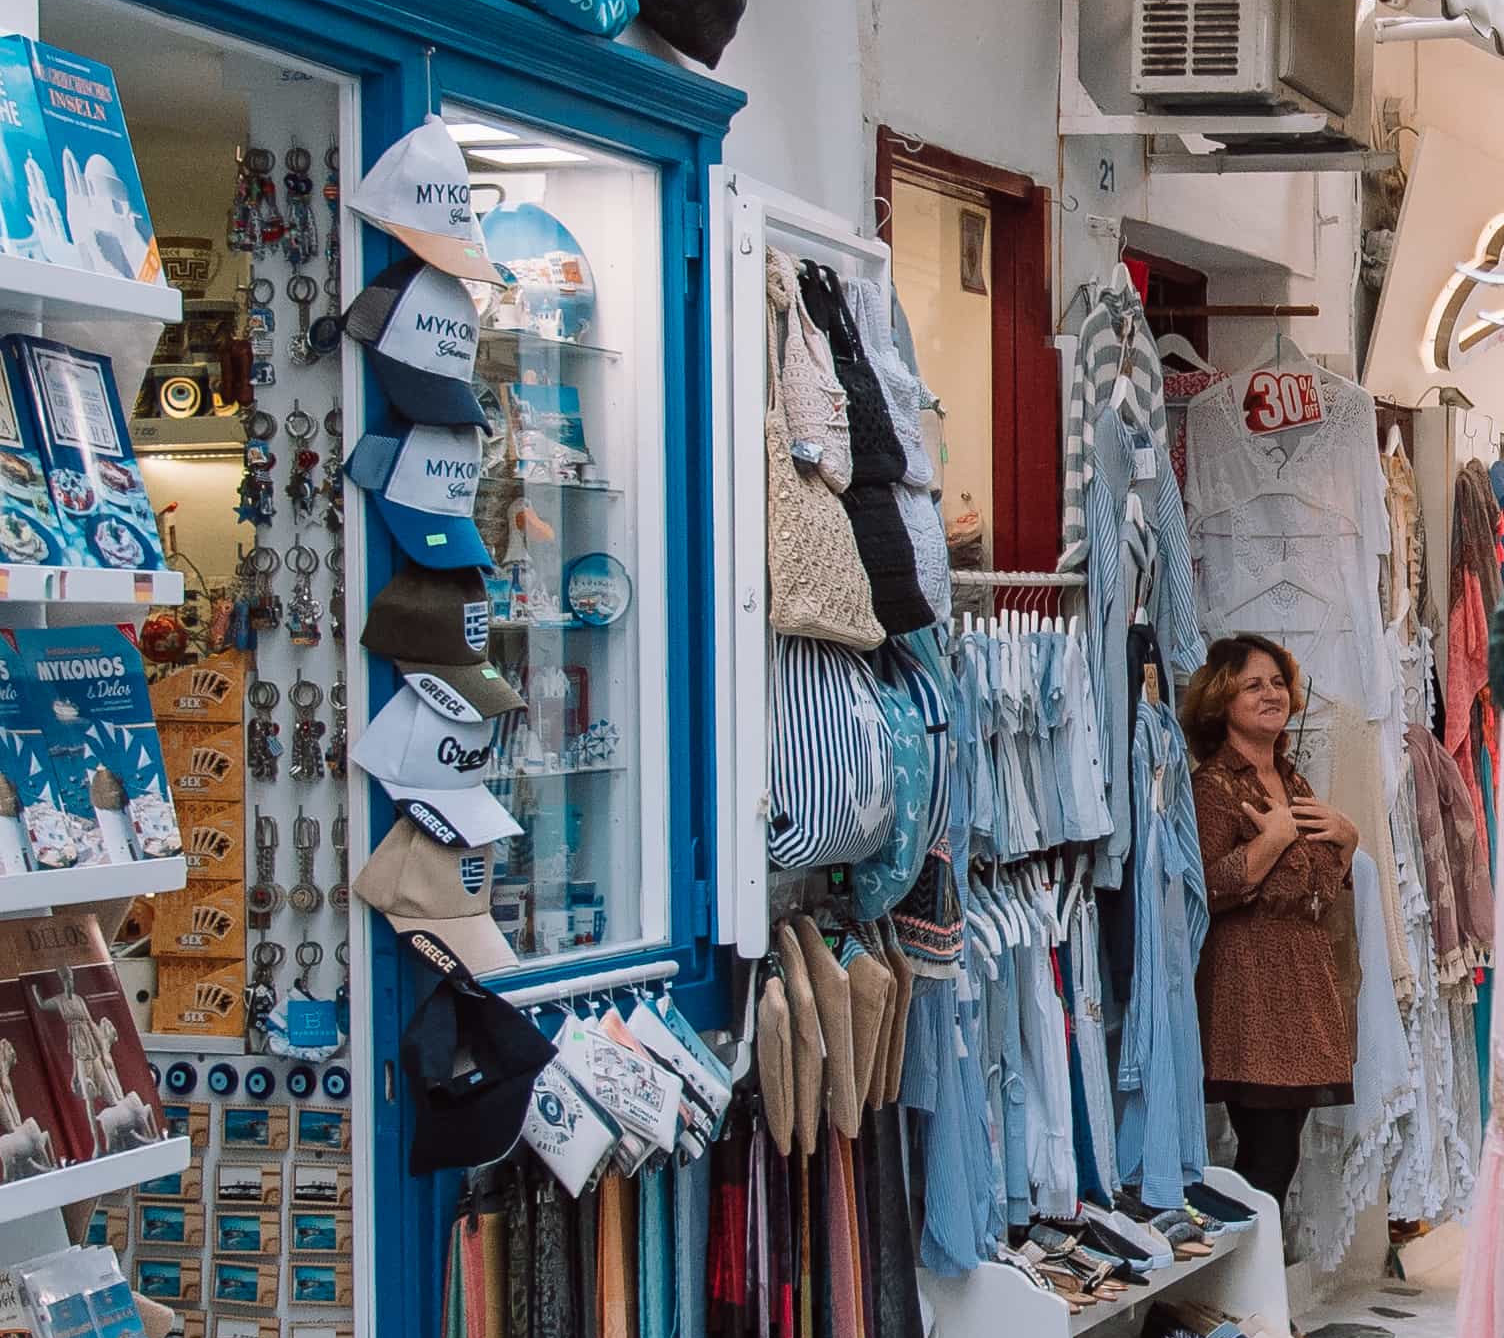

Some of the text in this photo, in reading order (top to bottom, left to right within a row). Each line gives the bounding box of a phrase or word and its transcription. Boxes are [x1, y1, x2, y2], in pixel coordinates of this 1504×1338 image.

[49, 89, 107, 122] INSELN
[1098, 158, 1115, 192] 21
[1304, 403, 1320, 420] OFF
[36, 656, 126, 682] MYKONOS
[97, 680, 133, 699] Delos
[418, 676, 466, 717] GREECE
[179, 697, 202, 709] SEX
[179, 776, 202, 789] SEX
[408, 802, 456, 846] GREECE
[186, 855, 201, 867] EX
[26, 924, 90, 952] DELOS
[180, 934, 203, 946] SEX
[410, 932, 457, 975] GREECE
[183, 1011, 208, 1023] SEX
